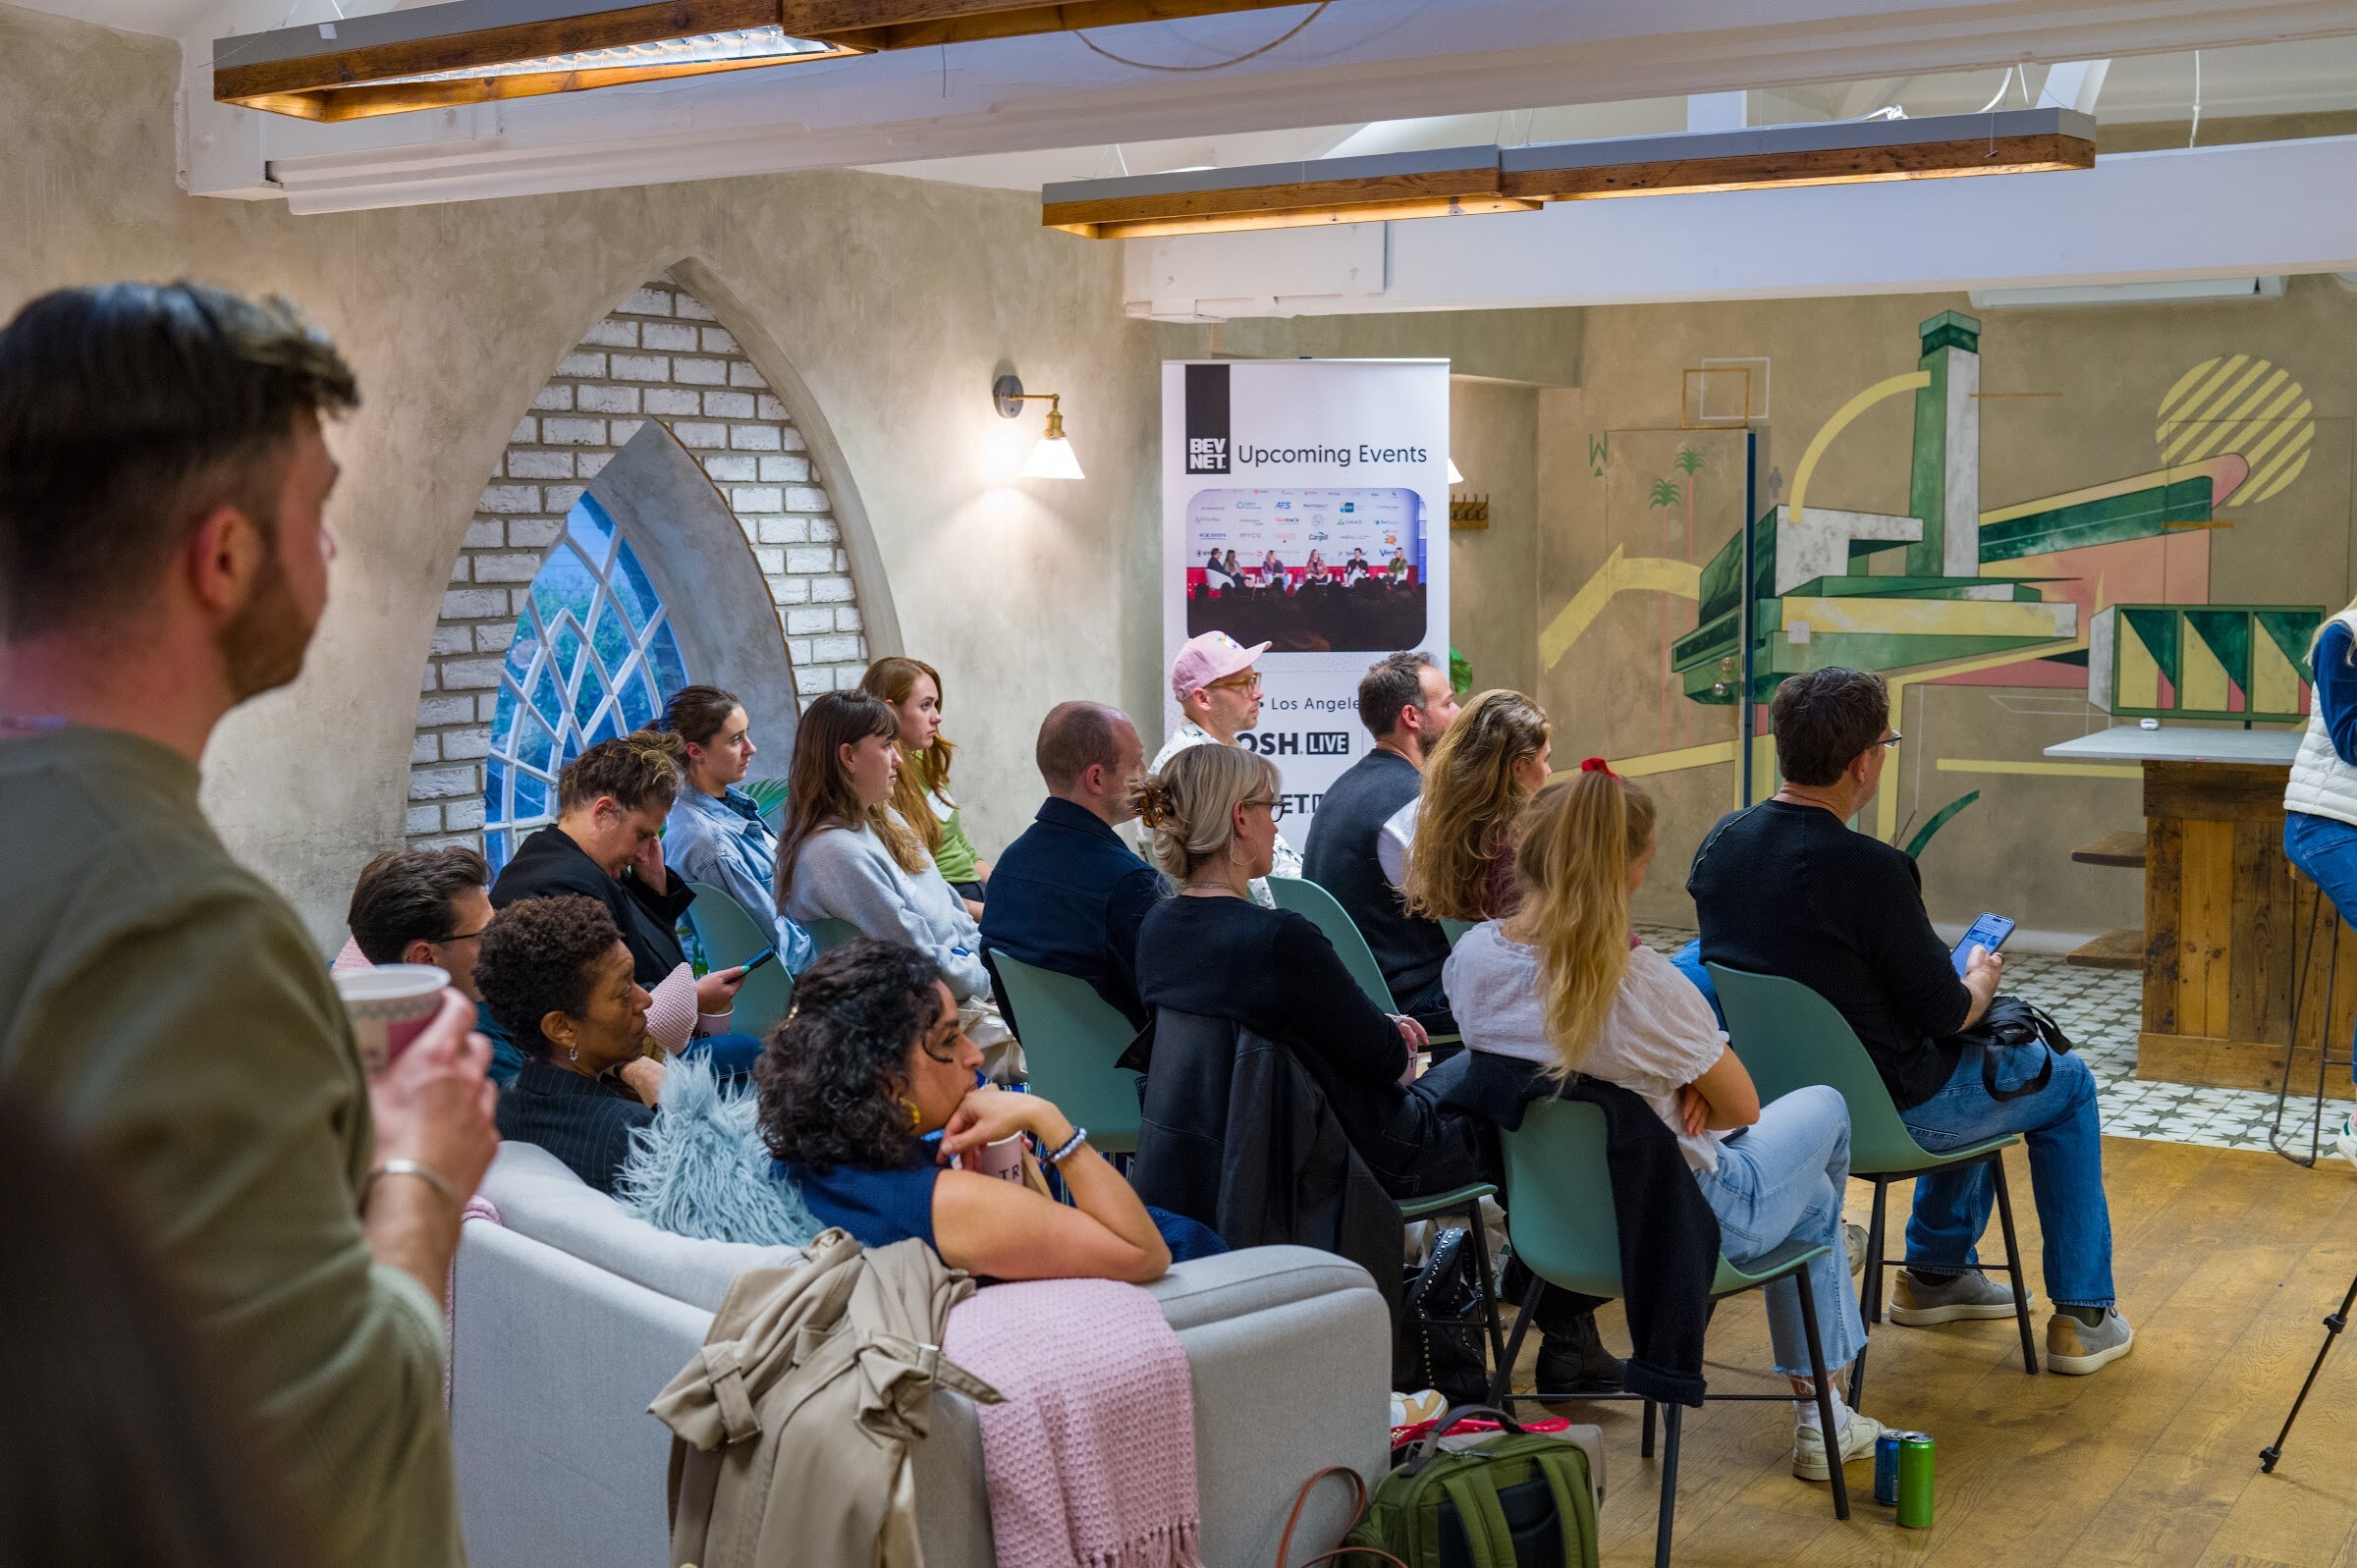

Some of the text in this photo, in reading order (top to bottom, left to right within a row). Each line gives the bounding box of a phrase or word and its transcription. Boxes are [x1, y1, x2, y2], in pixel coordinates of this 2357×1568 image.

[1189, 438, 1227, 454] BEV
[1238, 445, 1427, 467] Upcoming Events
[1272, 697, 1359, 712] Los Angele
[1236, 732, 1346, 755] OSH. LIVE
